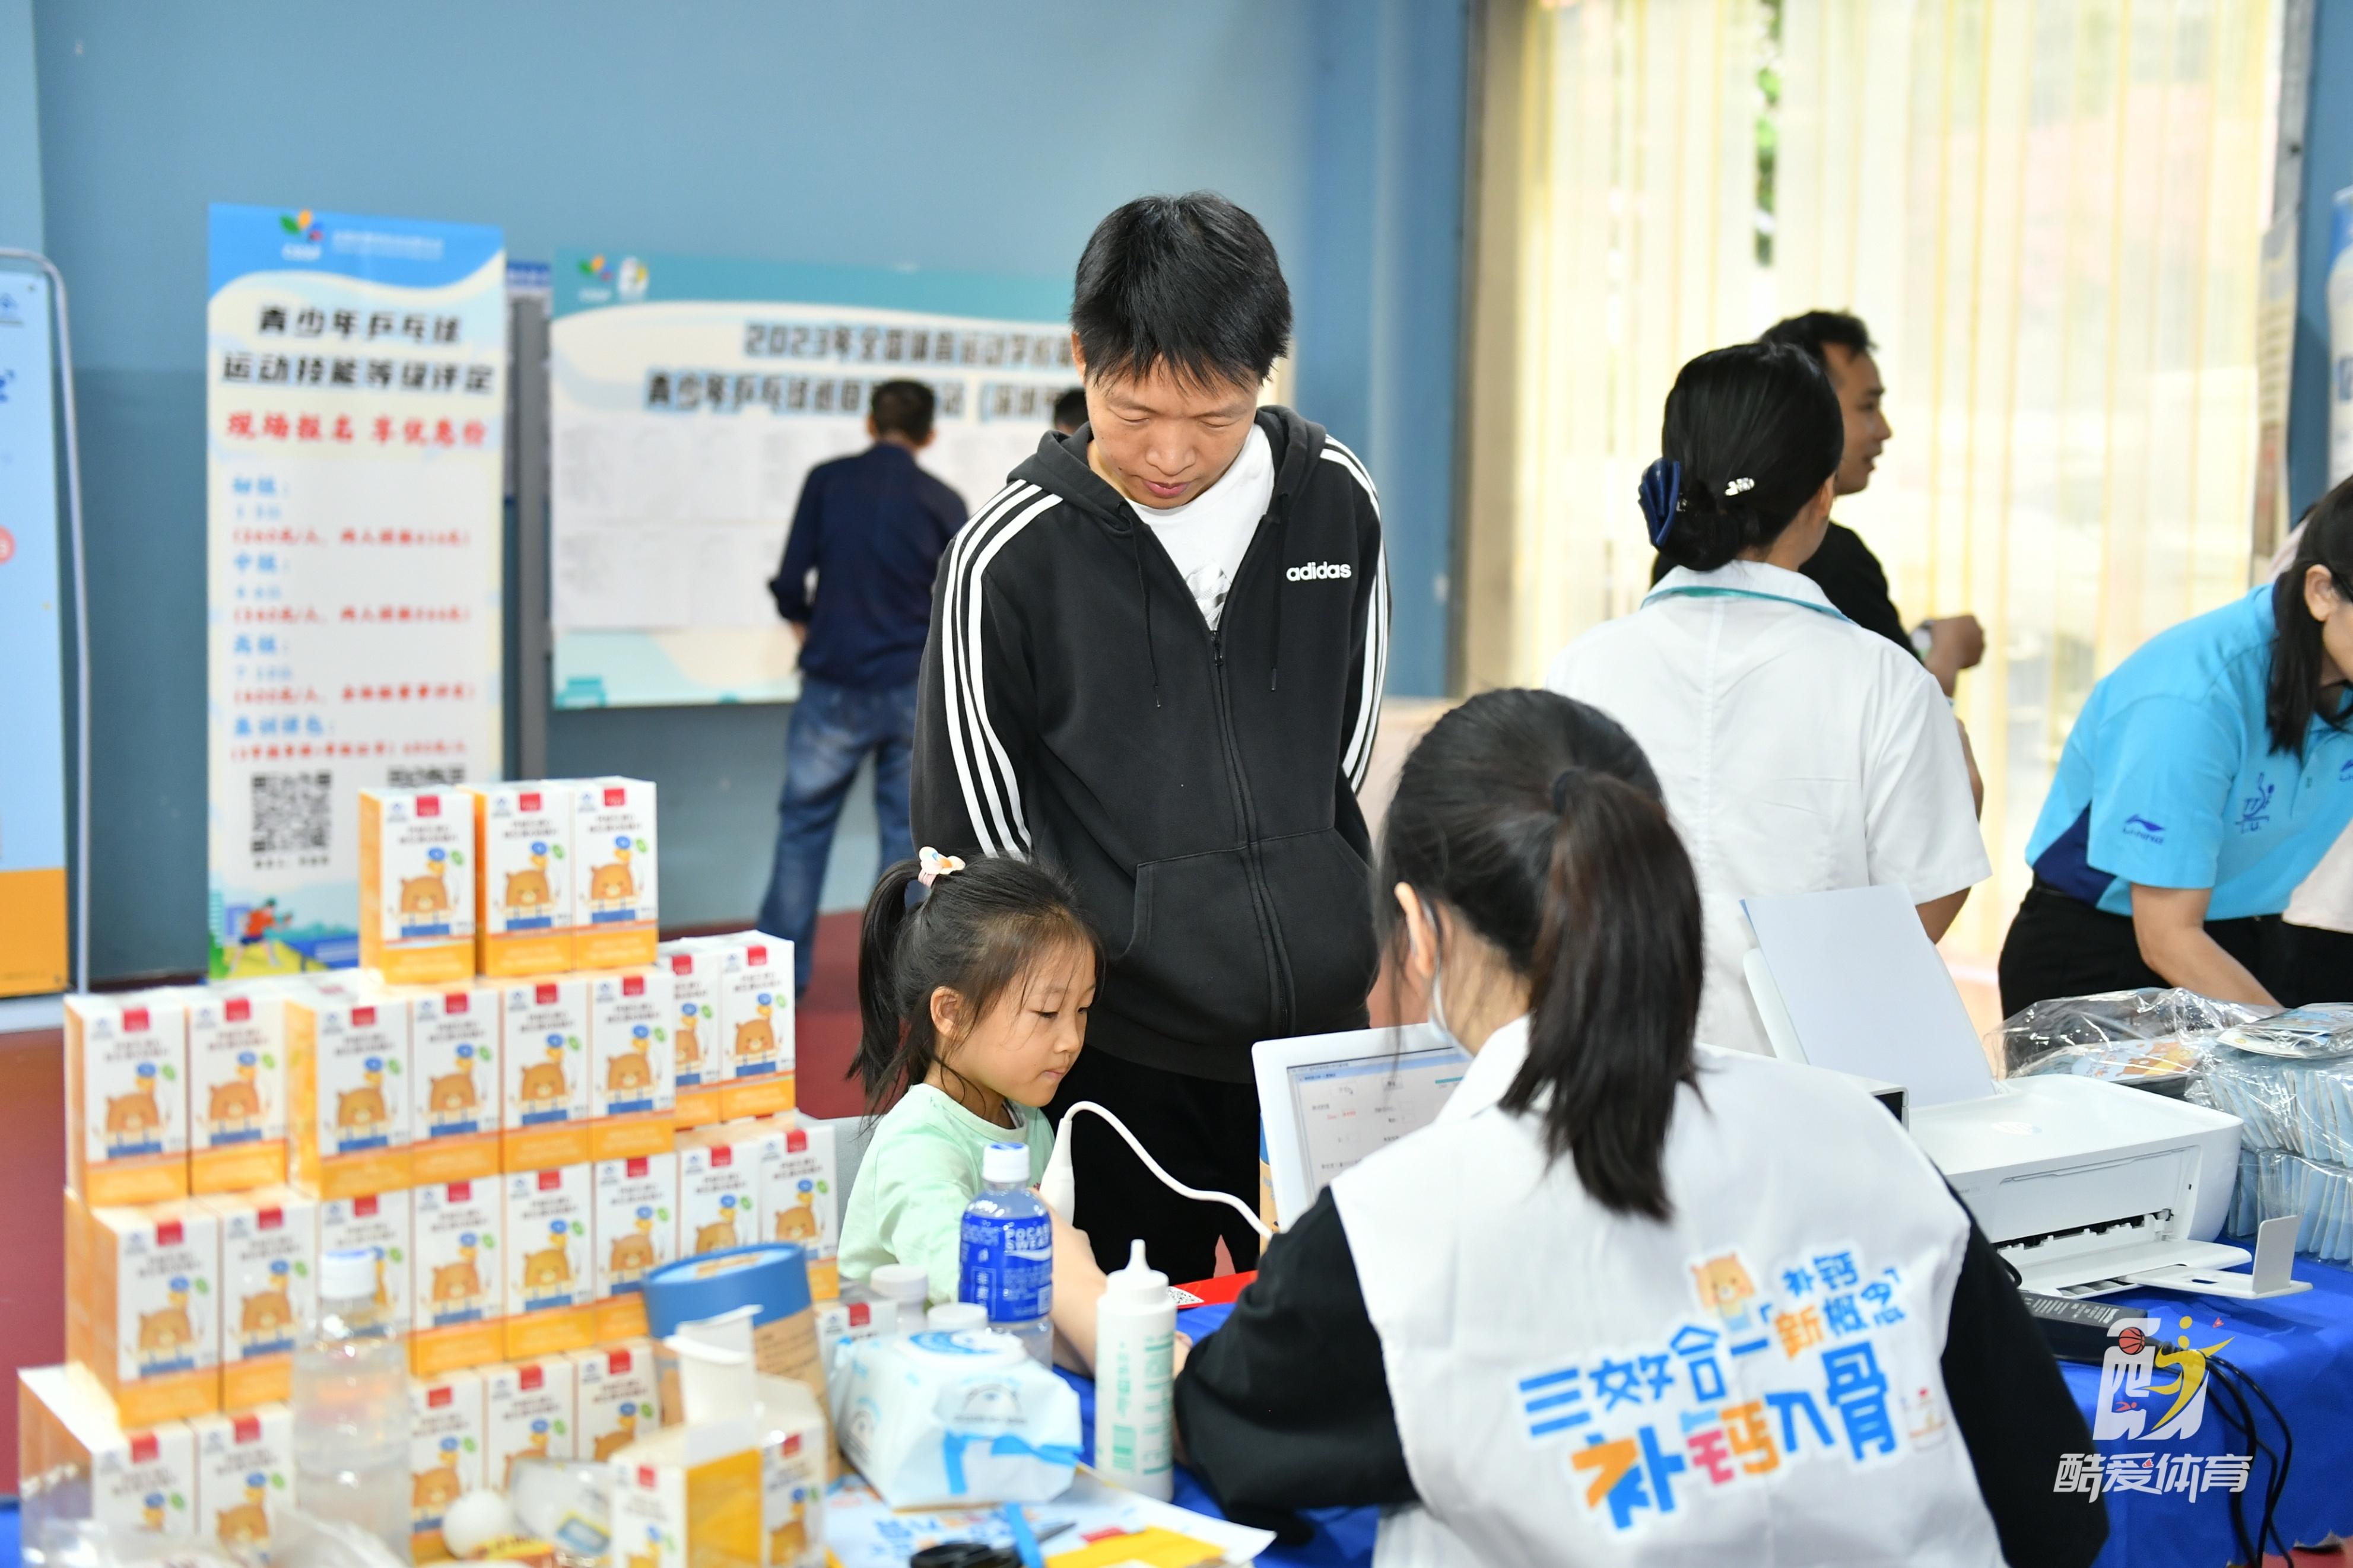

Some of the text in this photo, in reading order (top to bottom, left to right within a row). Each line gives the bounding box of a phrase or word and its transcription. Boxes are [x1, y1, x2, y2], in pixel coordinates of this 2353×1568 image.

[259, 306, 459, 344] 青少年乒乓球
[223, 352, 494, 394] 运动技能等级评定
[1286, 561, 1352, 582] adidas
